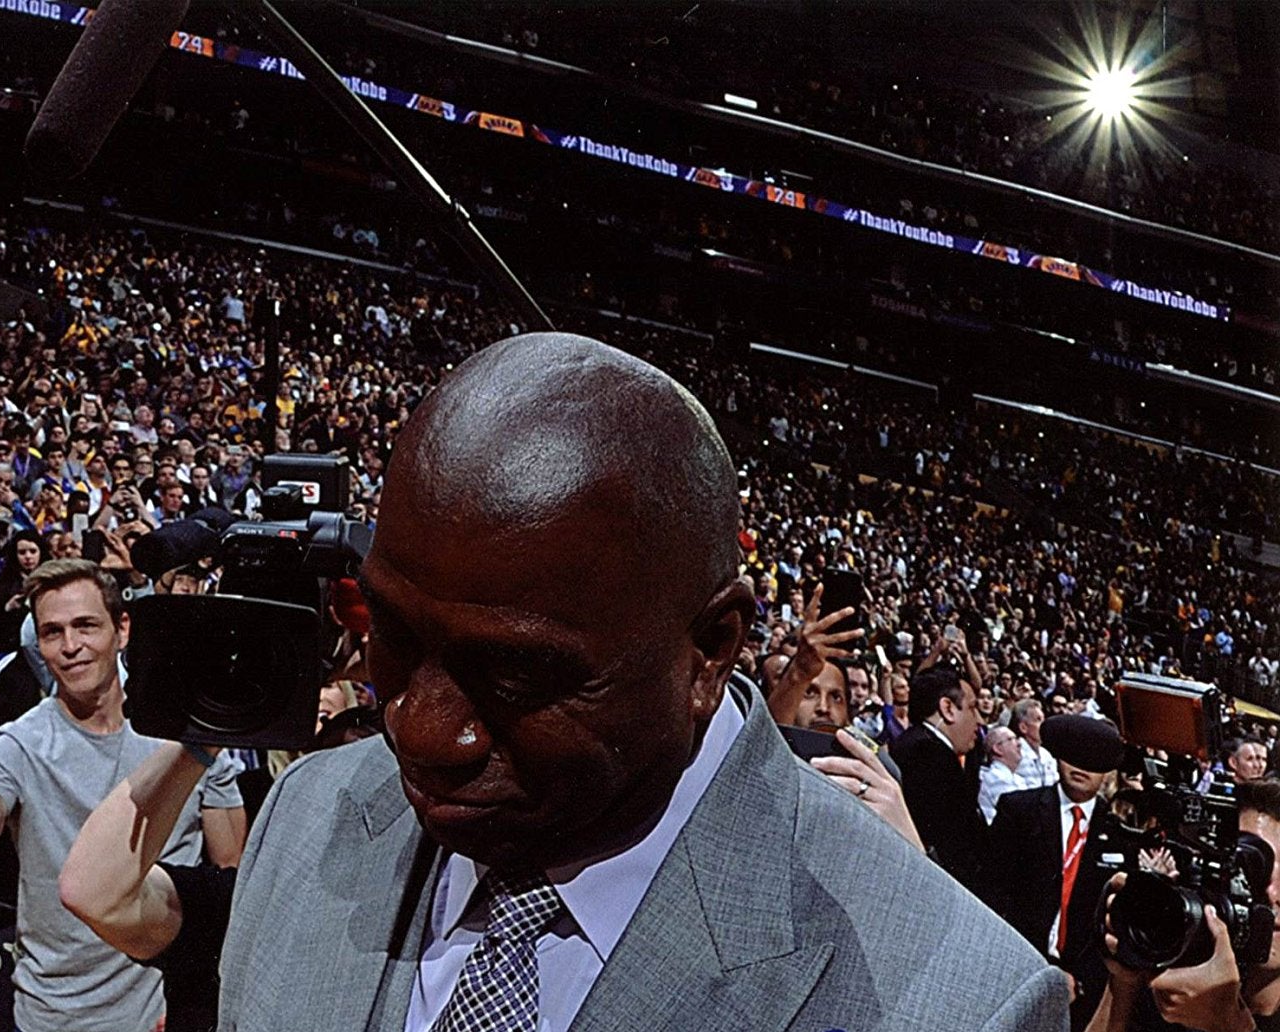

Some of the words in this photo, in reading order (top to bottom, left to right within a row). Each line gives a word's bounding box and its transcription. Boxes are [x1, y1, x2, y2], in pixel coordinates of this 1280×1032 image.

[561, 135, 678, 177] #ThankYouKobe
[843, 208, 954, 248] #ThankYouKobe
[1111, 279, 1217, 319] #ThankYouKobe
